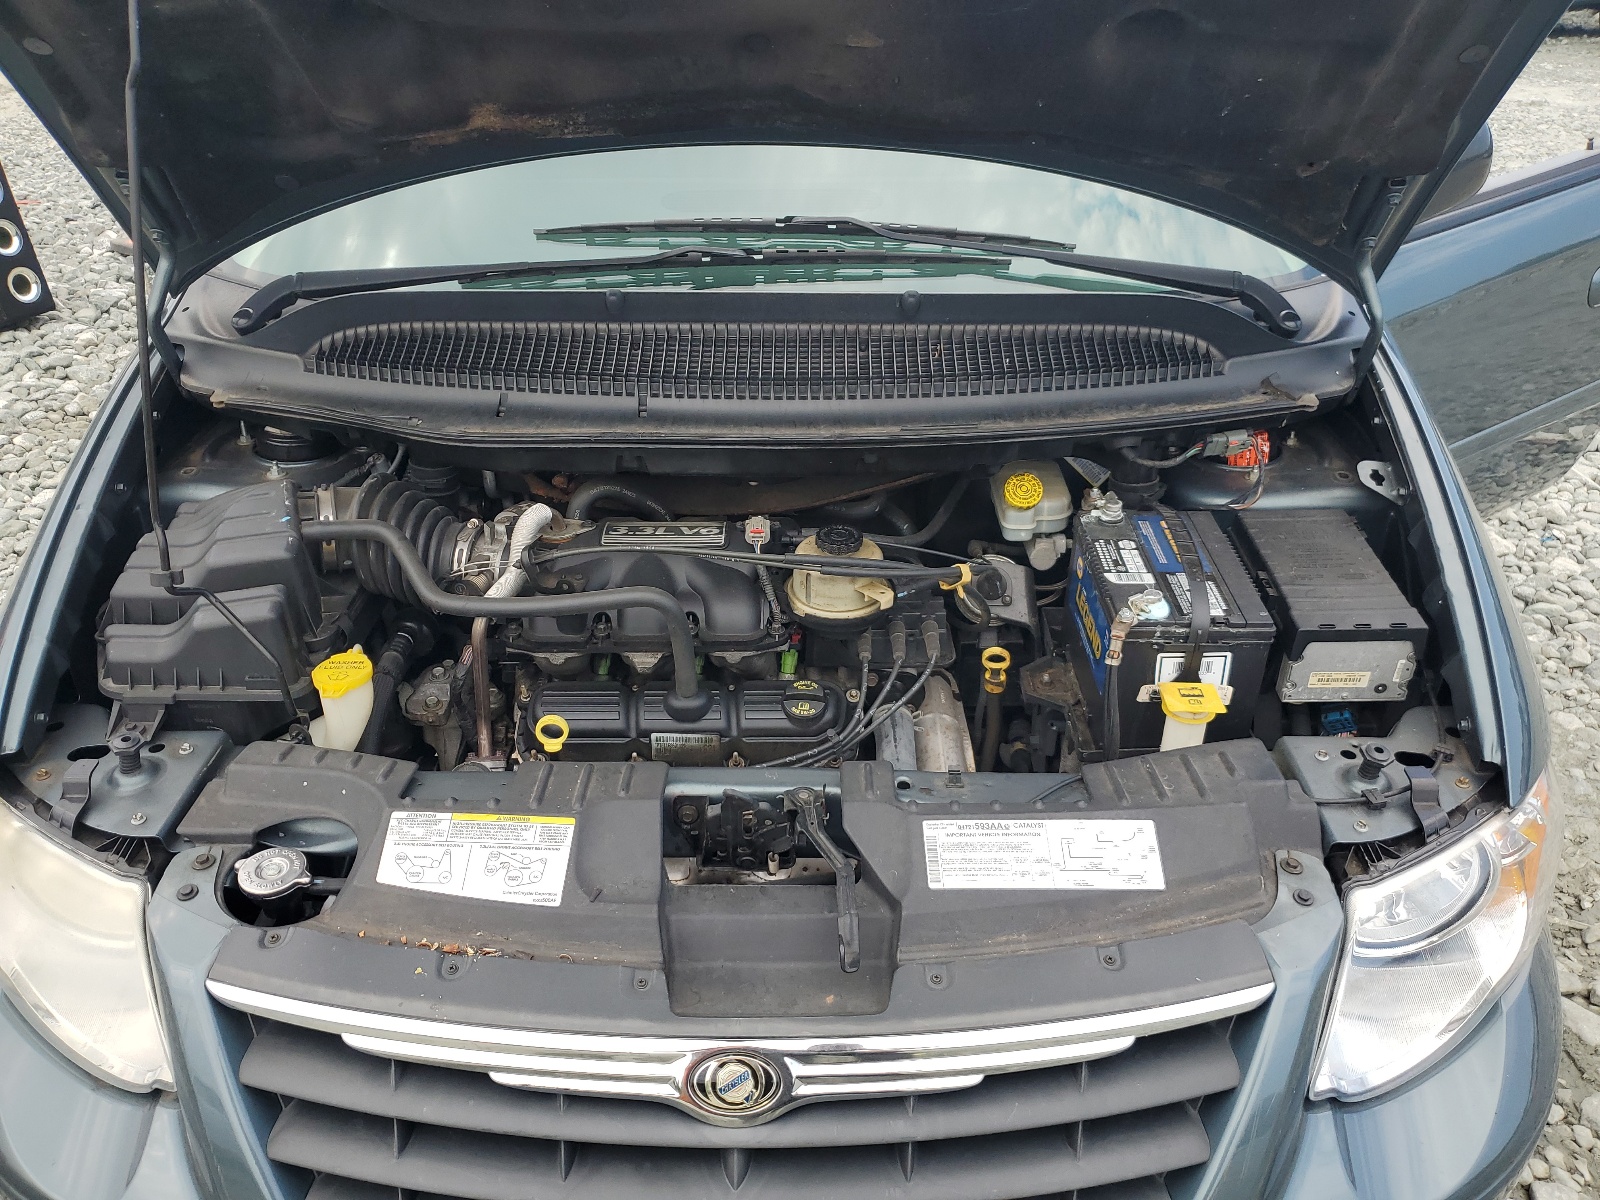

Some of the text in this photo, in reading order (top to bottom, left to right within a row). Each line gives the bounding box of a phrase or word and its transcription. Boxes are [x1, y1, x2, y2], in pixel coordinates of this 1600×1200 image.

[681, 526, 720, 535] V6
[1076, 582, 1102, 660] LEGEND
[720, 1070, 749, 1095] CHRYSLER
